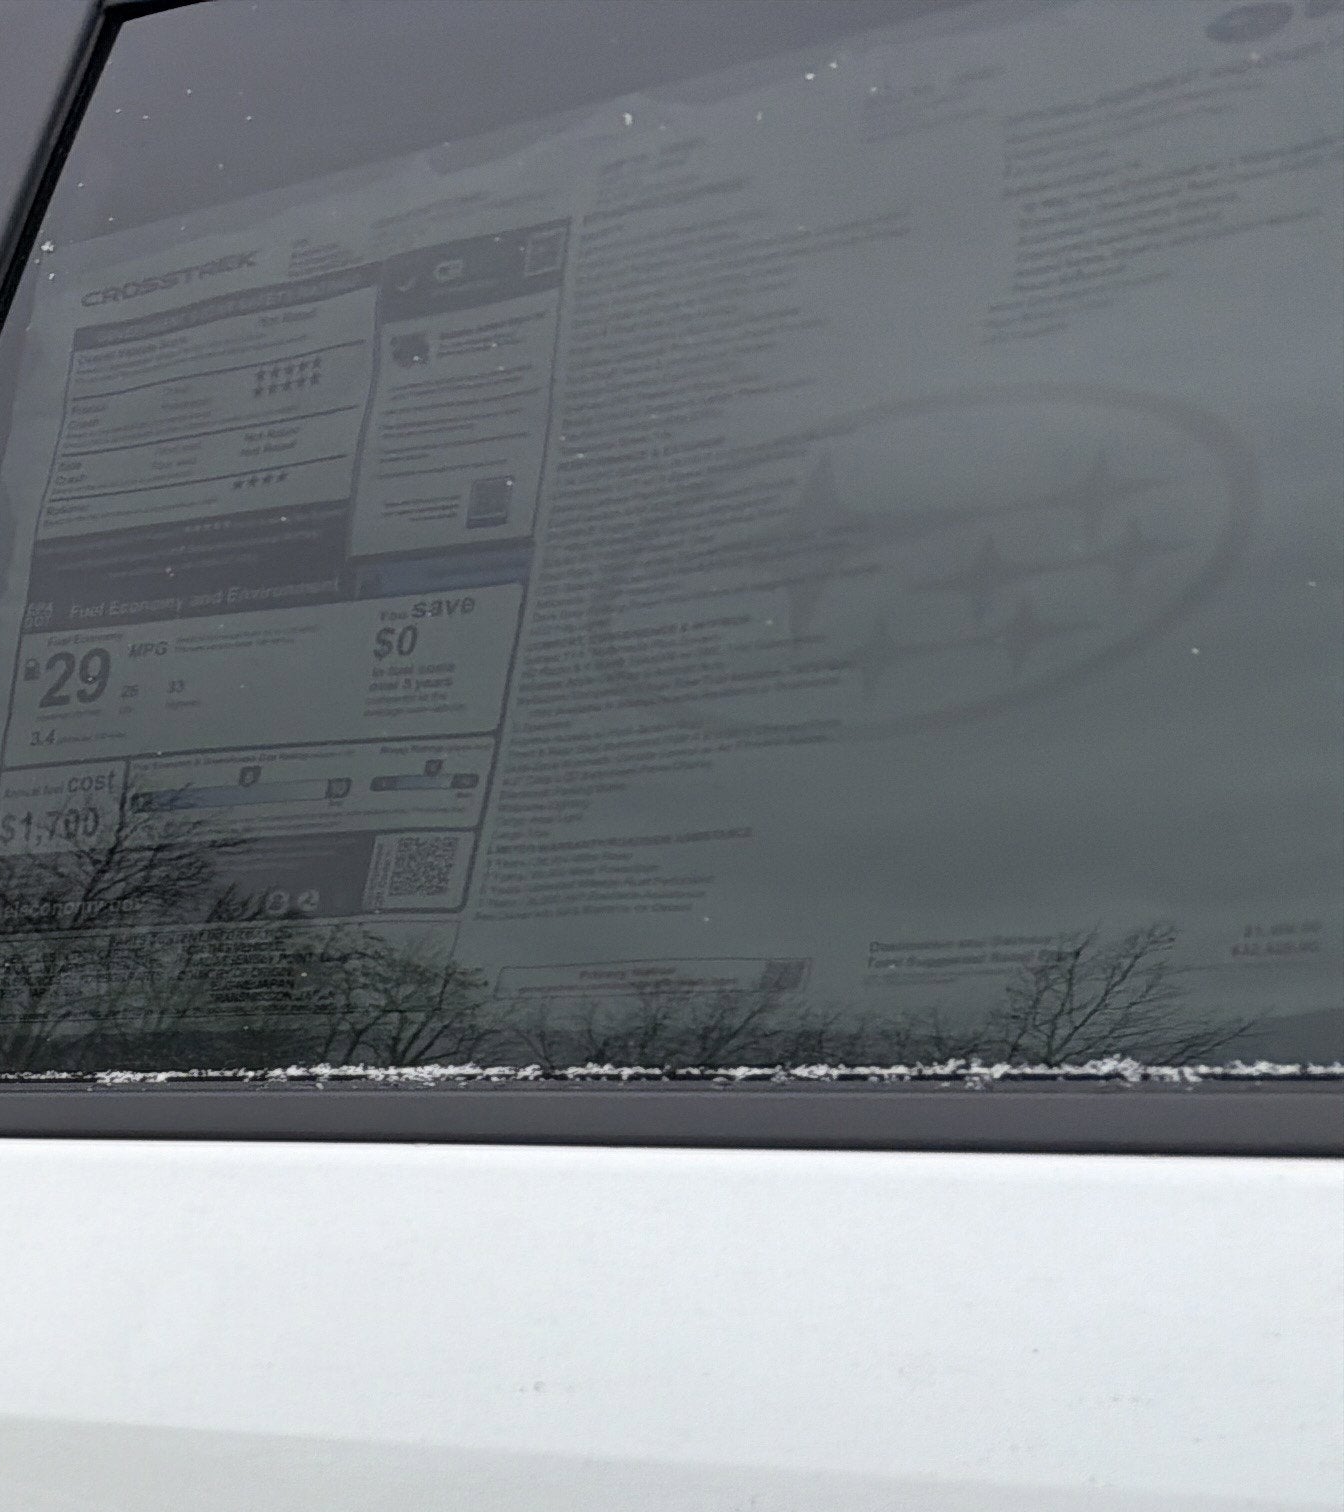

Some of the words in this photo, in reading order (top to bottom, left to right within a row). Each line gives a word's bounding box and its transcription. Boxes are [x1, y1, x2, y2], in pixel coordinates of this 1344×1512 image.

[80, 250, 259, 308] CROSSTREK
[69, 601, 106, 620] Fuel
[109, 596, 184, 618] Economy
[411, 596, 476, 619] save
[128, 641, 169, 658] MPG
[373, 624, 419, 661] $0
[38, 647, 112, 709] 29
[29, 729, 57, 747] 3.4
[67, 769, 117, 794] cost
